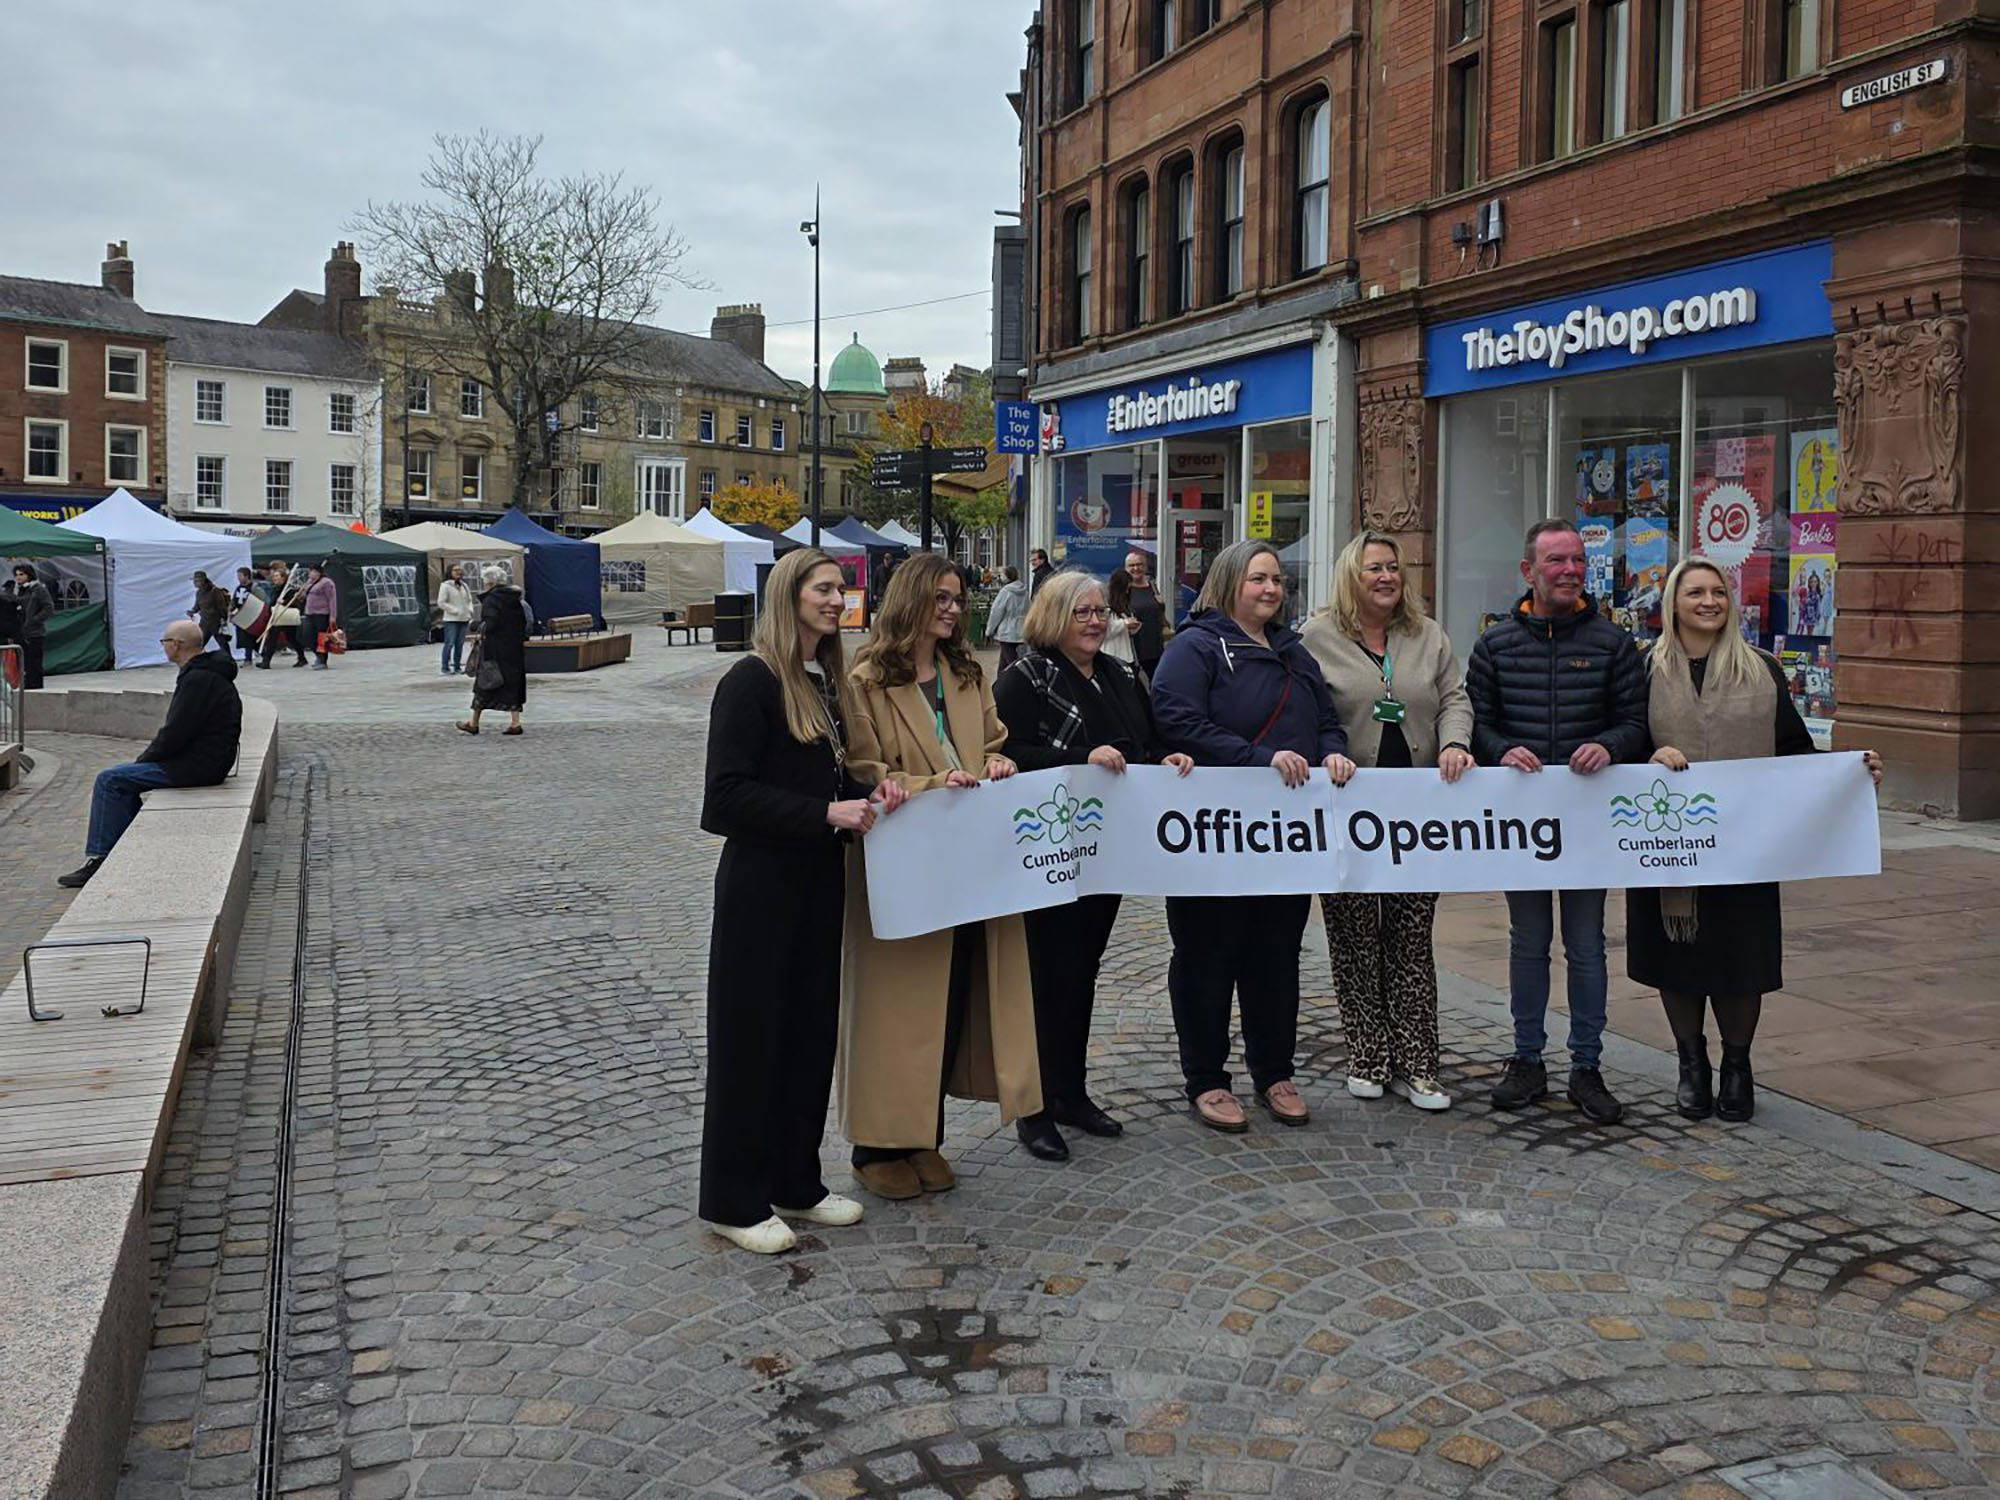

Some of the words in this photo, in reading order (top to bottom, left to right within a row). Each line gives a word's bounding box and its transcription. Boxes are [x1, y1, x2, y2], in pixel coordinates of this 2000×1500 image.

[1851, 70, 1911, 103] ENGLISH
[1917, 64, 1934, 82] ST
[1462, 287, 1755, 371] TheToyShop.com
[1007, 406, 1031, 419] The
[1114, 377, 1241, 432] Entertainer
[1007, 421, 1030, 437] Toy
[1002, 435, 1036, 452] Shop
[1798, 521, 1835, 546] Barbie
[1156, 807, 1328, 854] Official
[1348, 808, 1562, 865] Opening
[1618, 834, 1717, 851] Cumberland
[1639, 852, 1698, 868] Council
